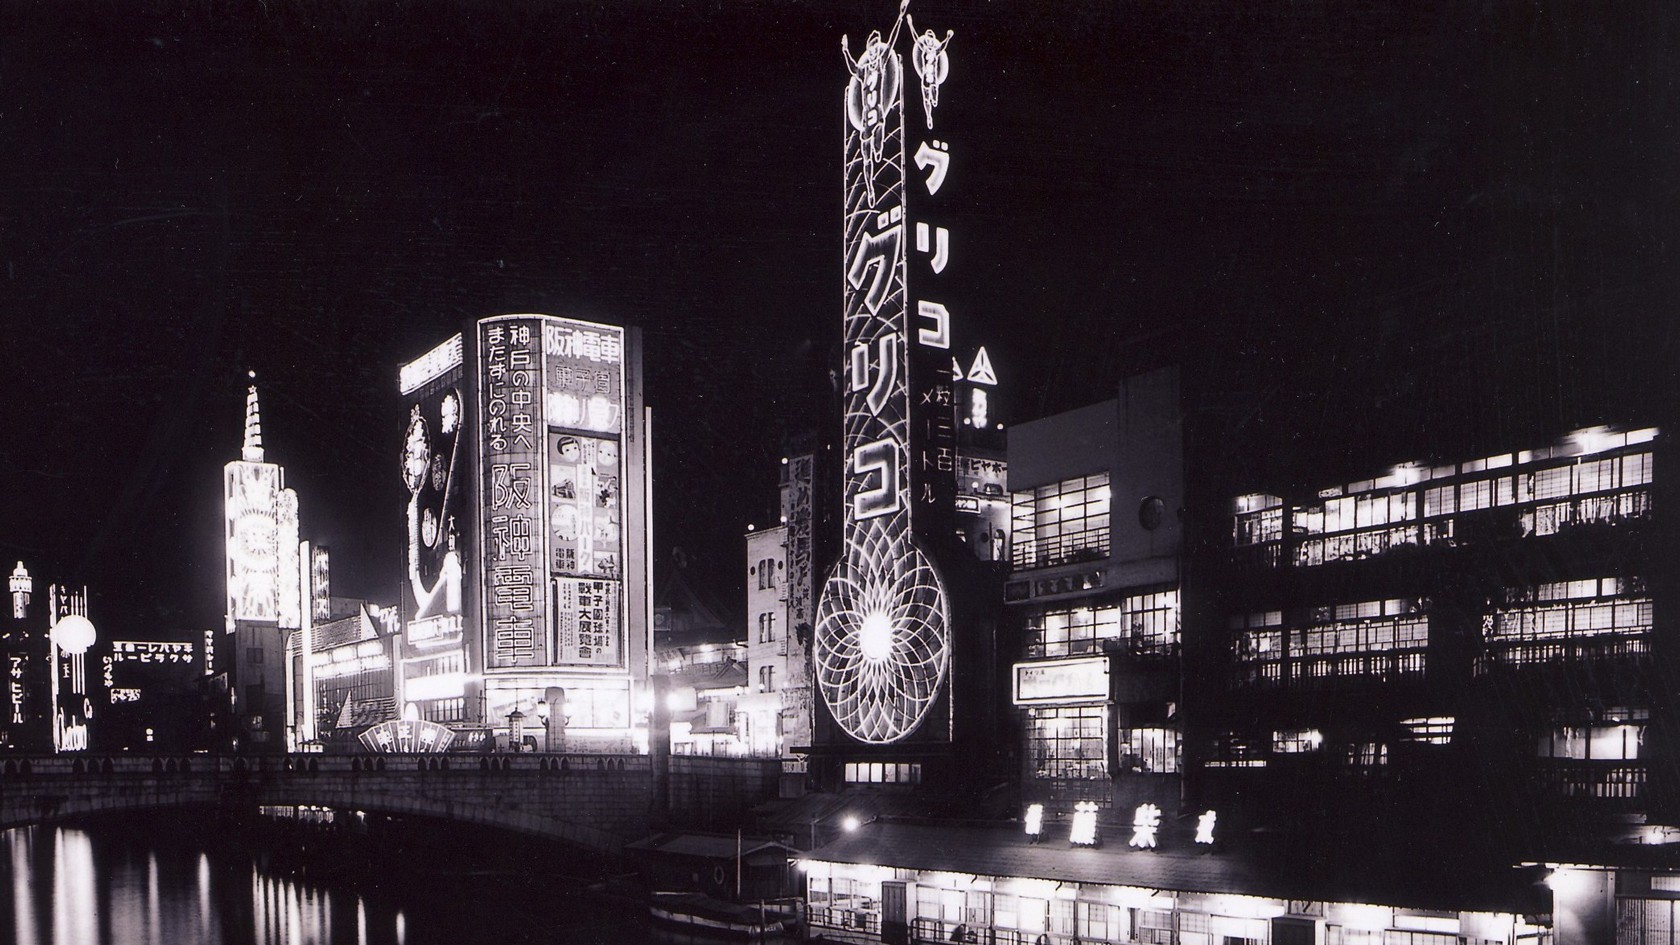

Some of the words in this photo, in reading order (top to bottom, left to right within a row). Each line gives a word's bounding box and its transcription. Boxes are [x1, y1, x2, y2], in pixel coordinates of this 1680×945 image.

[913, 140, 950, 349] グリコ
[488, 327, 507, 450] またずにのれる
[509, 325, 533, 449] 神戸の中央へ
[546, 325, 619, 363] 阪神電車
[847, 205, 902, 521] グリコ
[920, 389, 935, 503] メートル
[492, 464, 534, 662] 阪神電車
[10, 657, 23, 723] アサヒビール
